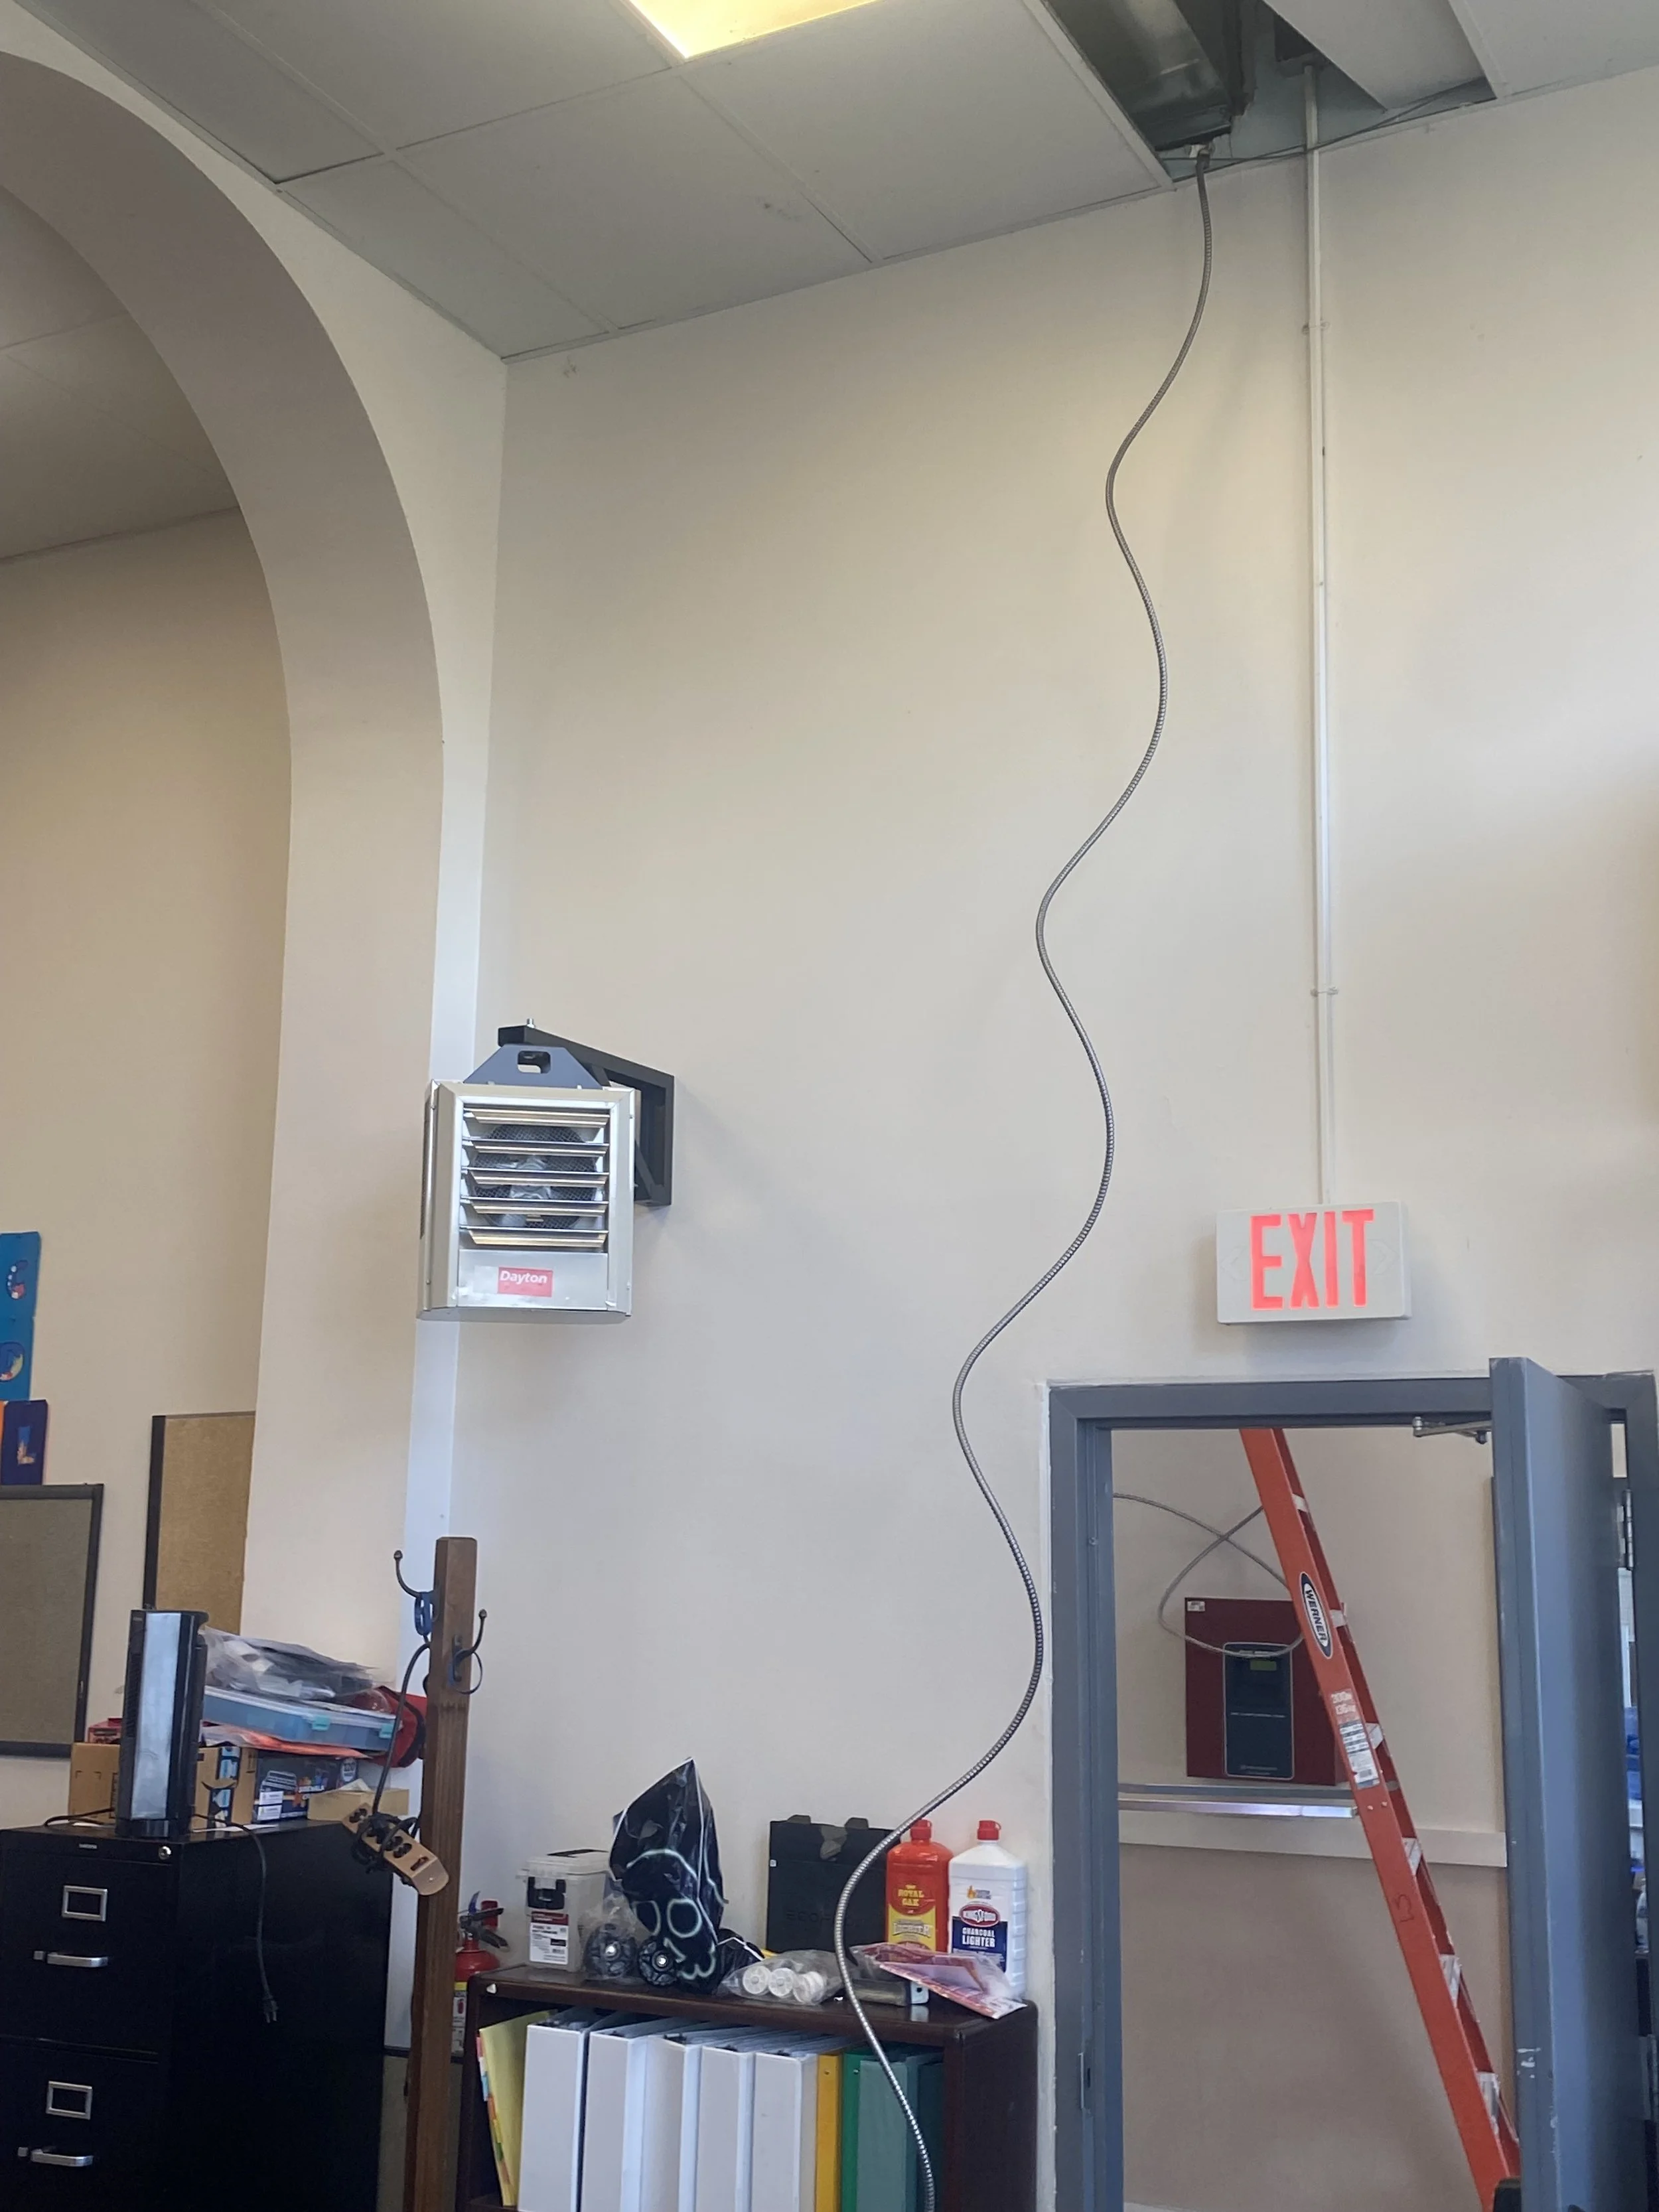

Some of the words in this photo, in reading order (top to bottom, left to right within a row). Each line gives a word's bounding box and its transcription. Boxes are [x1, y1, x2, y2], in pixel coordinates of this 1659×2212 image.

[1250, 1209, 1374, 1310] EXIT
[500, 1270, 547, 1285] Dayton
[1305, 1589, 1327, 1641] WERNER
[962, 1927, 995, 1937] CHARCOAL
[962, 1935, 995, 1947] LIGHTER
